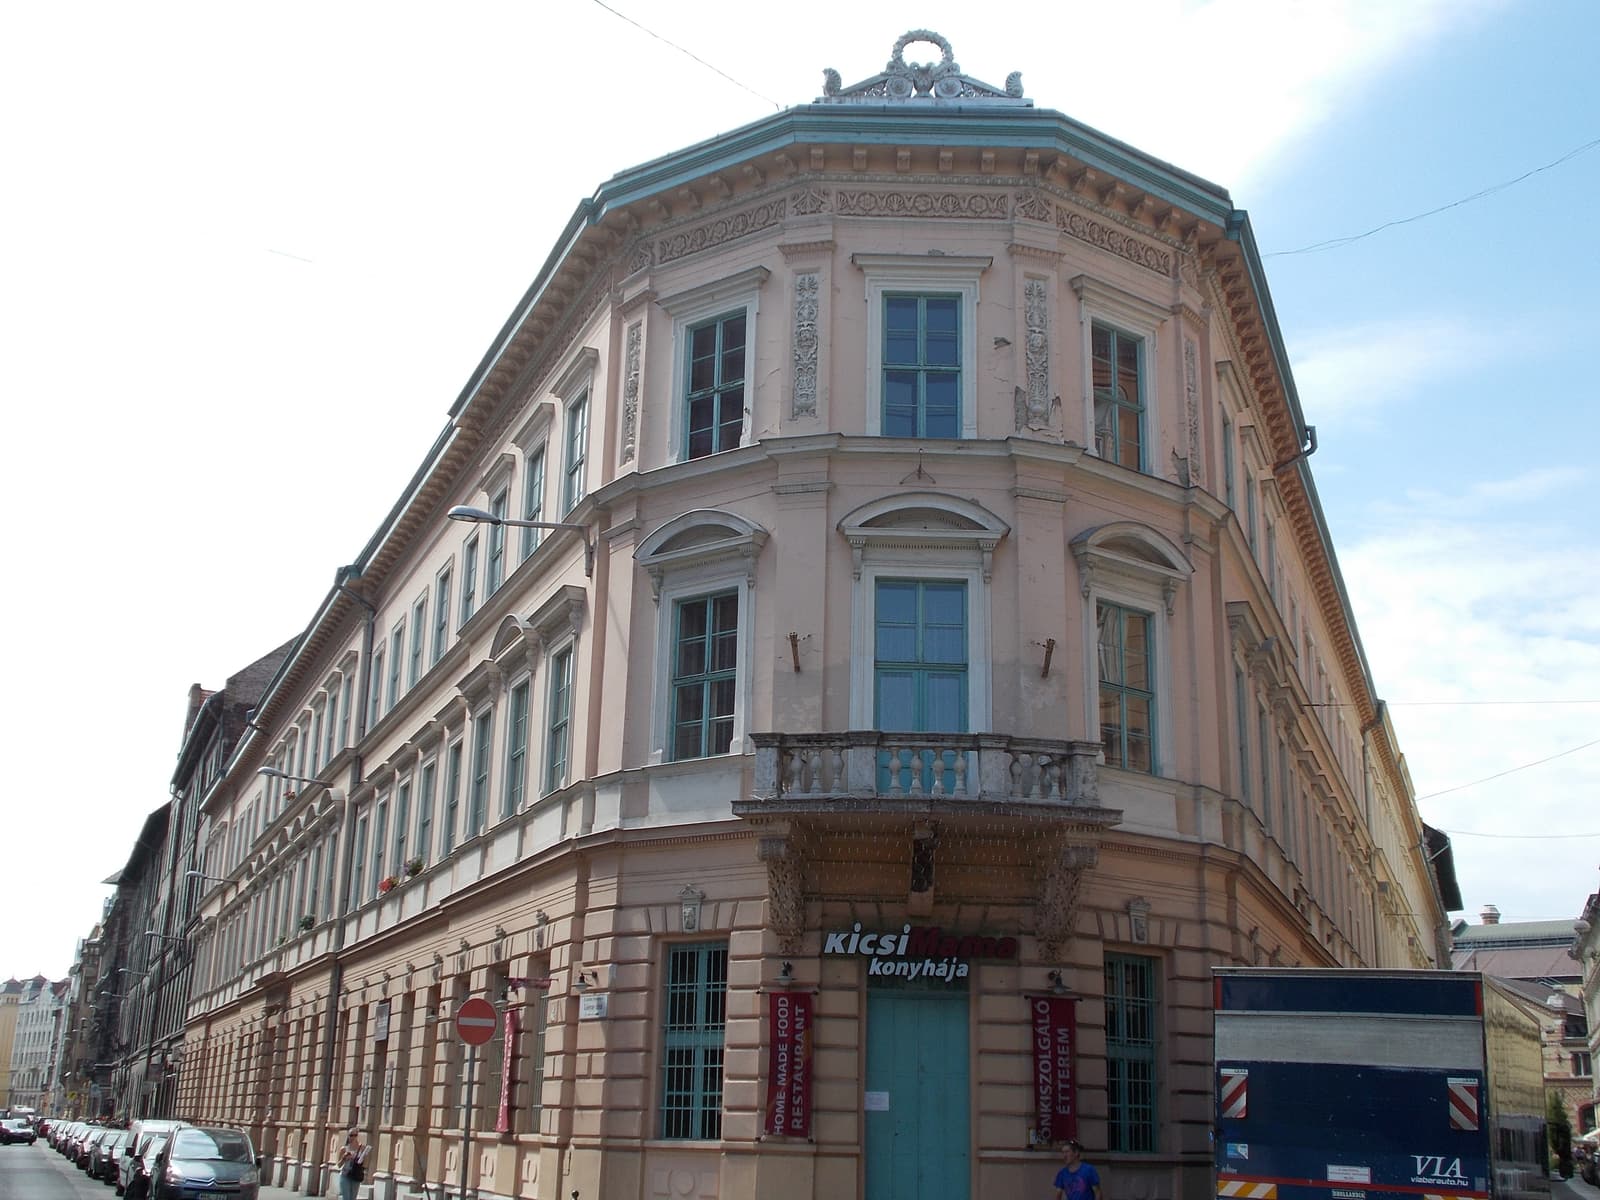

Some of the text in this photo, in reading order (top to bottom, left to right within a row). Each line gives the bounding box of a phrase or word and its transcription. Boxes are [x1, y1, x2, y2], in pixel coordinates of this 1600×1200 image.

[868, 957, 969, 982] konyhája
[774, 997, 789, 1135] HOME MADE FOOD
[791, 1004, 806, 1129] RESTAURANT
[1056, 1027, 1071, 1115] ÉTTEREM
[1410, 1155, 1468, 1178] VIA
